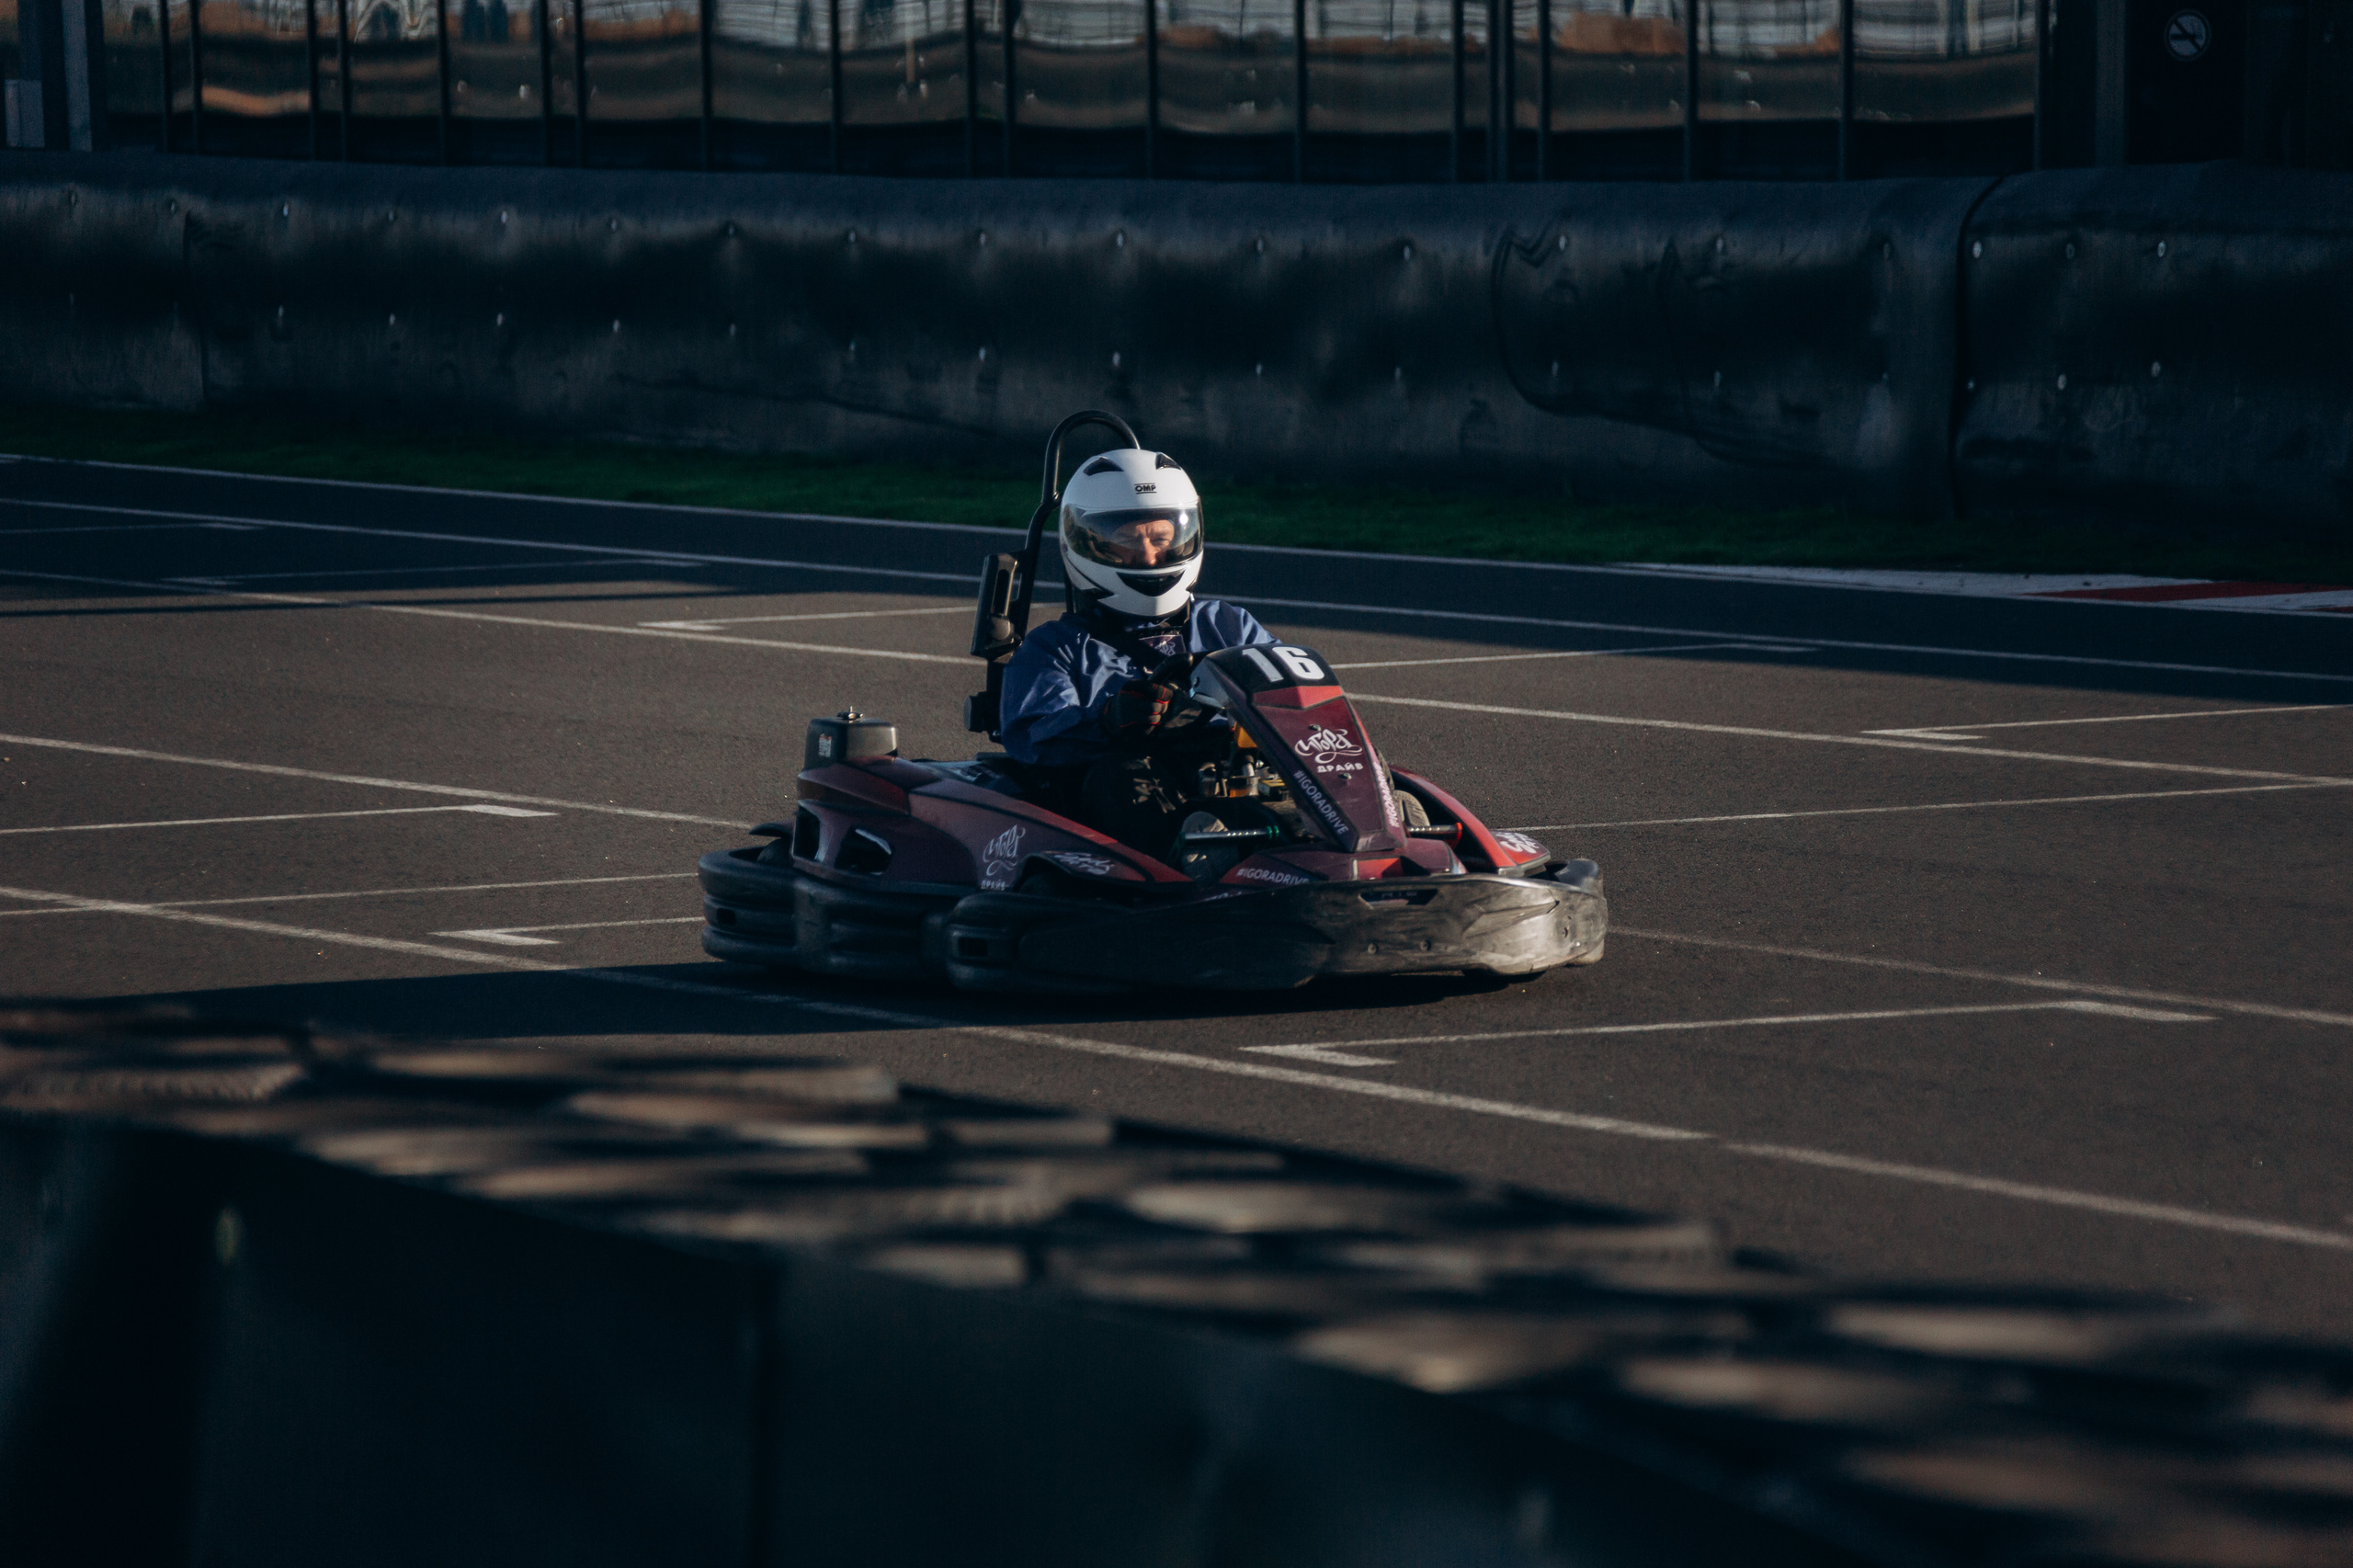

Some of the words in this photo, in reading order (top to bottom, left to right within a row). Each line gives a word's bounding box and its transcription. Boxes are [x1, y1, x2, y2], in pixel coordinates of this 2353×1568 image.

[1135, 484, 1156, 493] OMP
[1242, 646, 1325, 683] 16
[1317, 762, 1364, 773] ДРАЙВ
[1293, 770, 1349, 835] #IGORADRIVE
